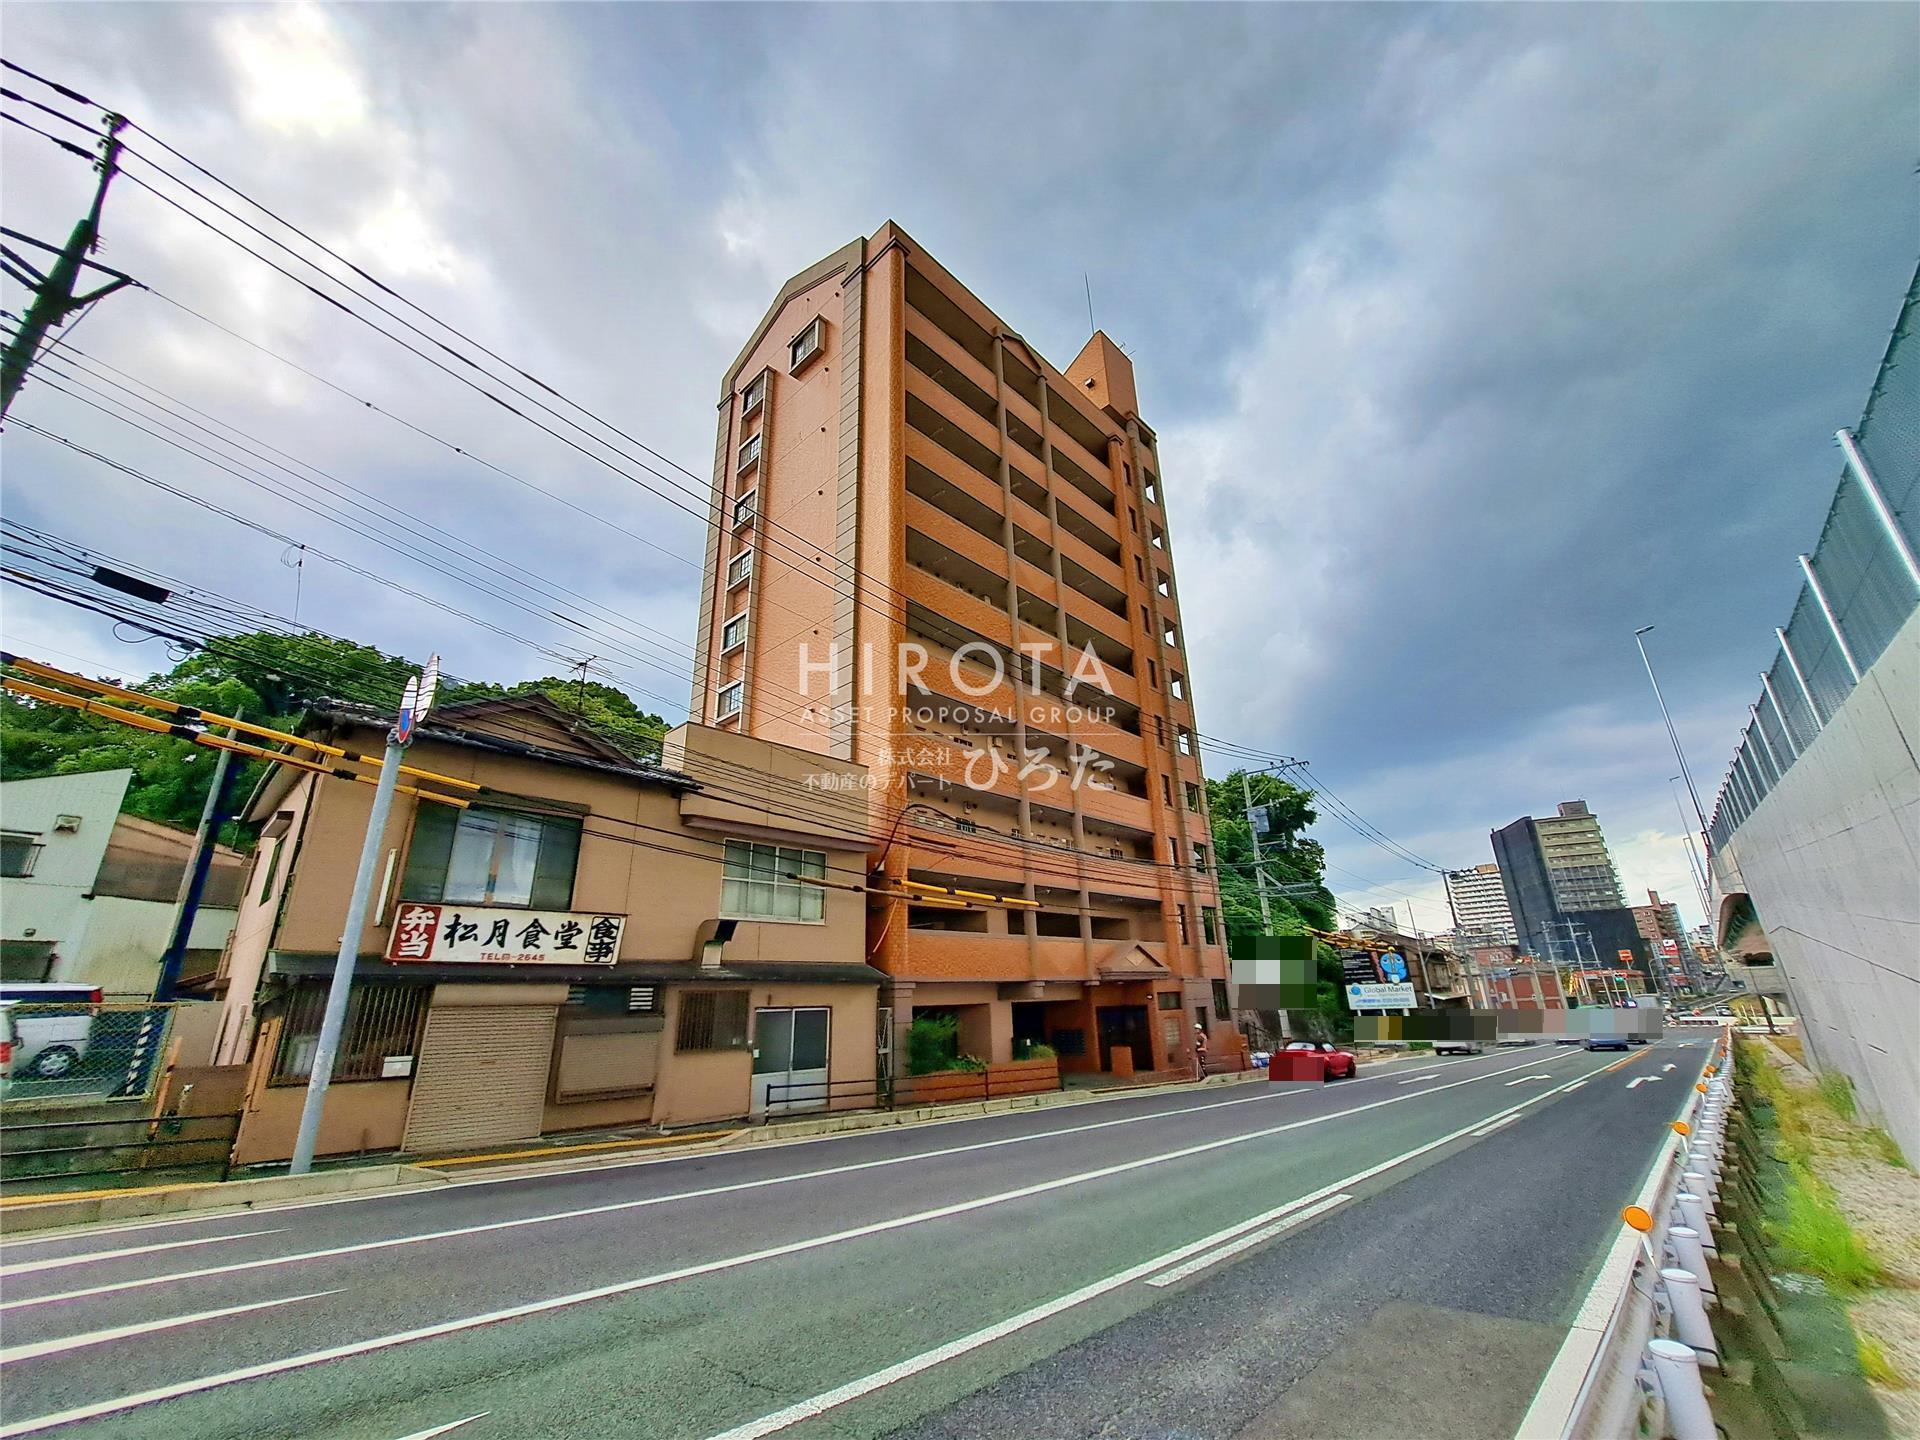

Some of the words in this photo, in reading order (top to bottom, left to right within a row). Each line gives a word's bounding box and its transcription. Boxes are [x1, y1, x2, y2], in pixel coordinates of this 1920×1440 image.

[399, 907, 435, 957] 弁当
[444, 913, 583, 950] 松月食堂
[585, 918, 618, 961] 食事
[1363, 985, 1387, 993] Global
[1388, 985, 1412, 993] Market
